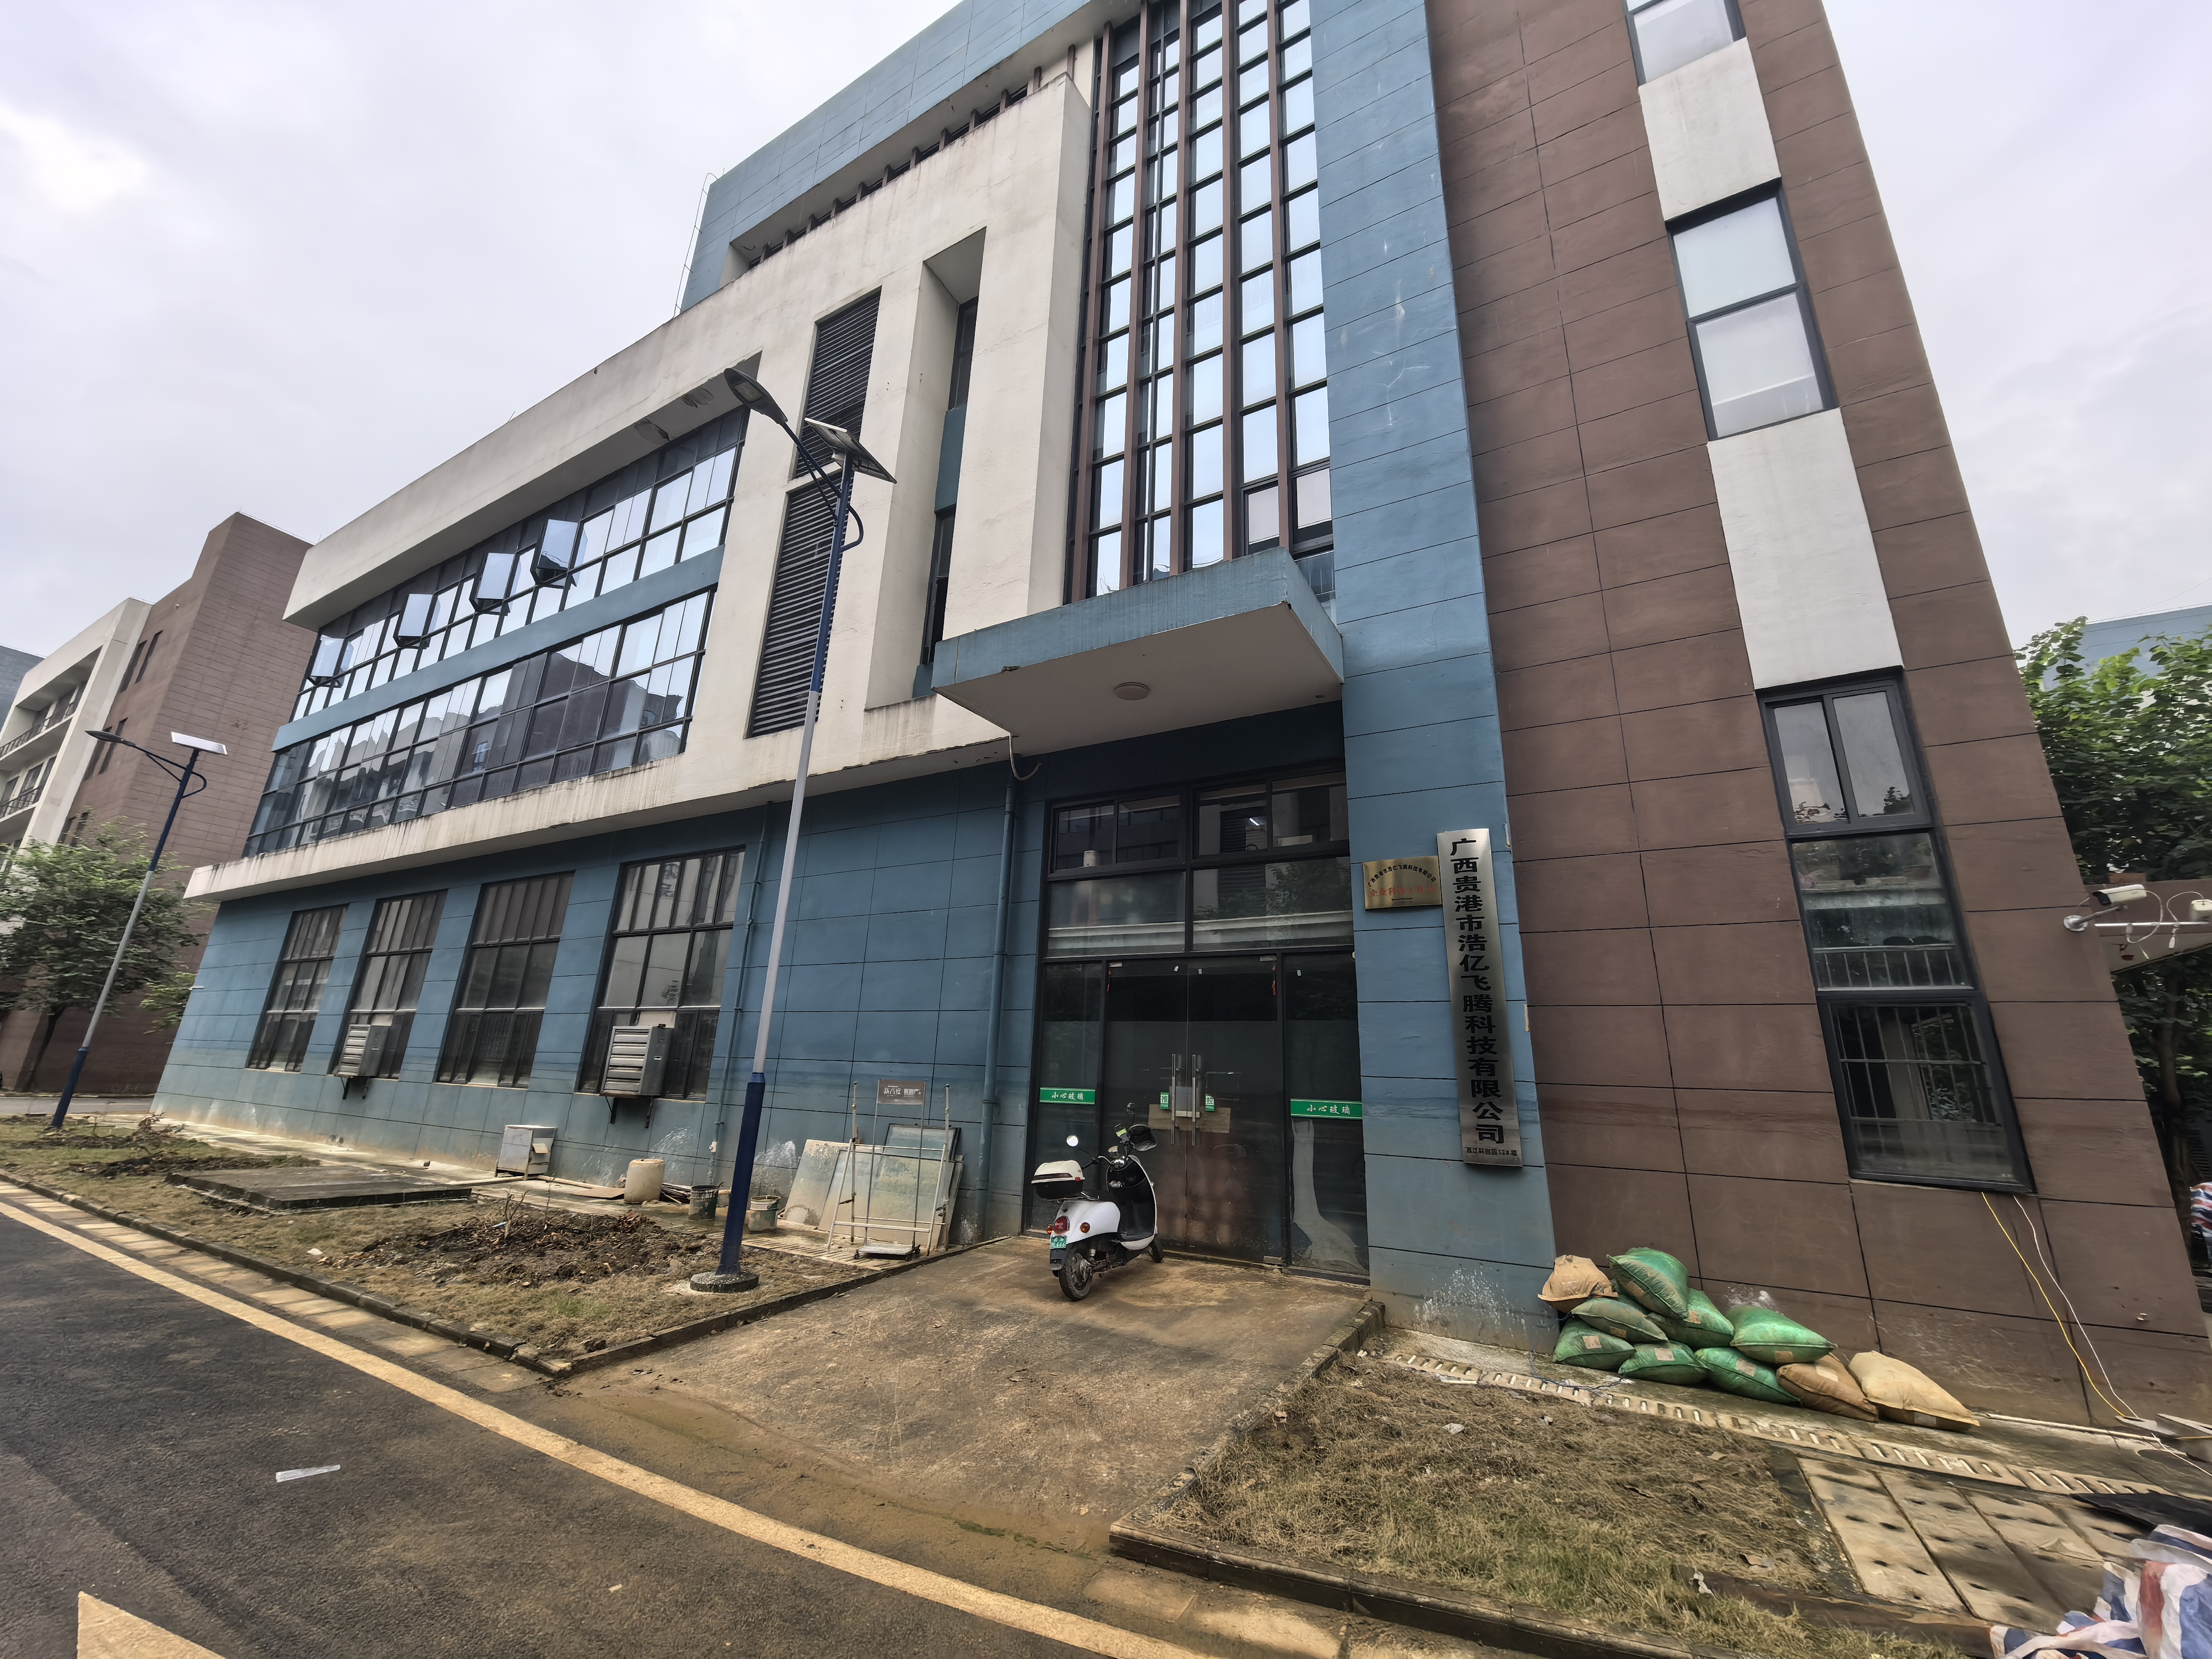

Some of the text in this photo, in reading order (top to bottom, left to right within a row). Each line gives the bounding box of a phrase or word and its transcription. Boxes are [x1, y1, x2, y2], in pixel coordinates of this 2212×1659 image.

[1450, 837, 1505, 1144] 广西贵港市浩亿飞腾科技有限公司
[1051, 1092, 1084, 1101] 小心玻璃
[1307, 1104, 1350, 1115] 小心玻璃
